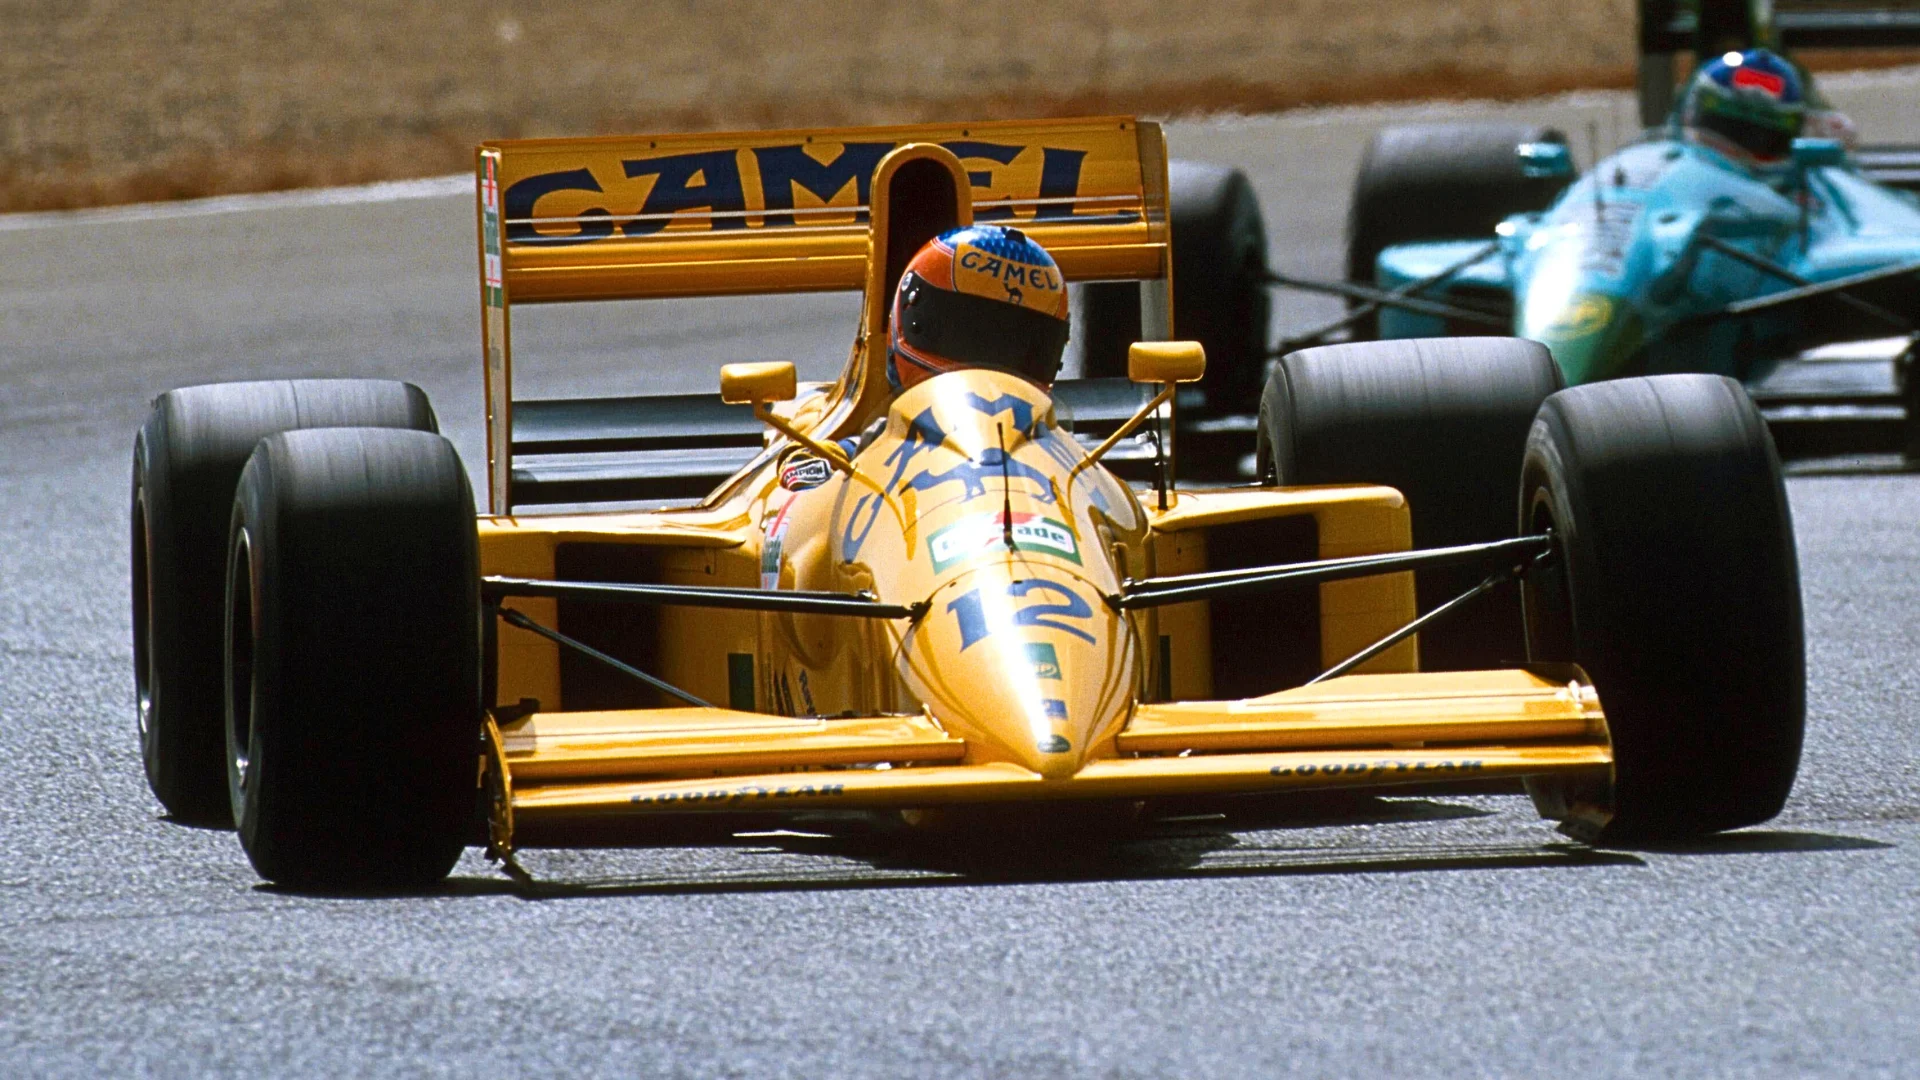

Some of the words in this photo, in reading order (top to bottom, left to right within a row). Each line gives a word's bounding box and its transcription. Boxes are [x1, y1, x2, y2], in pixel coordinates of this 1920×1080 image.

[505, 141, 1141, 247] CAMEL
[961, 251, 1059, 291] CAMEL
[946, 577, 1097, 654] 12
